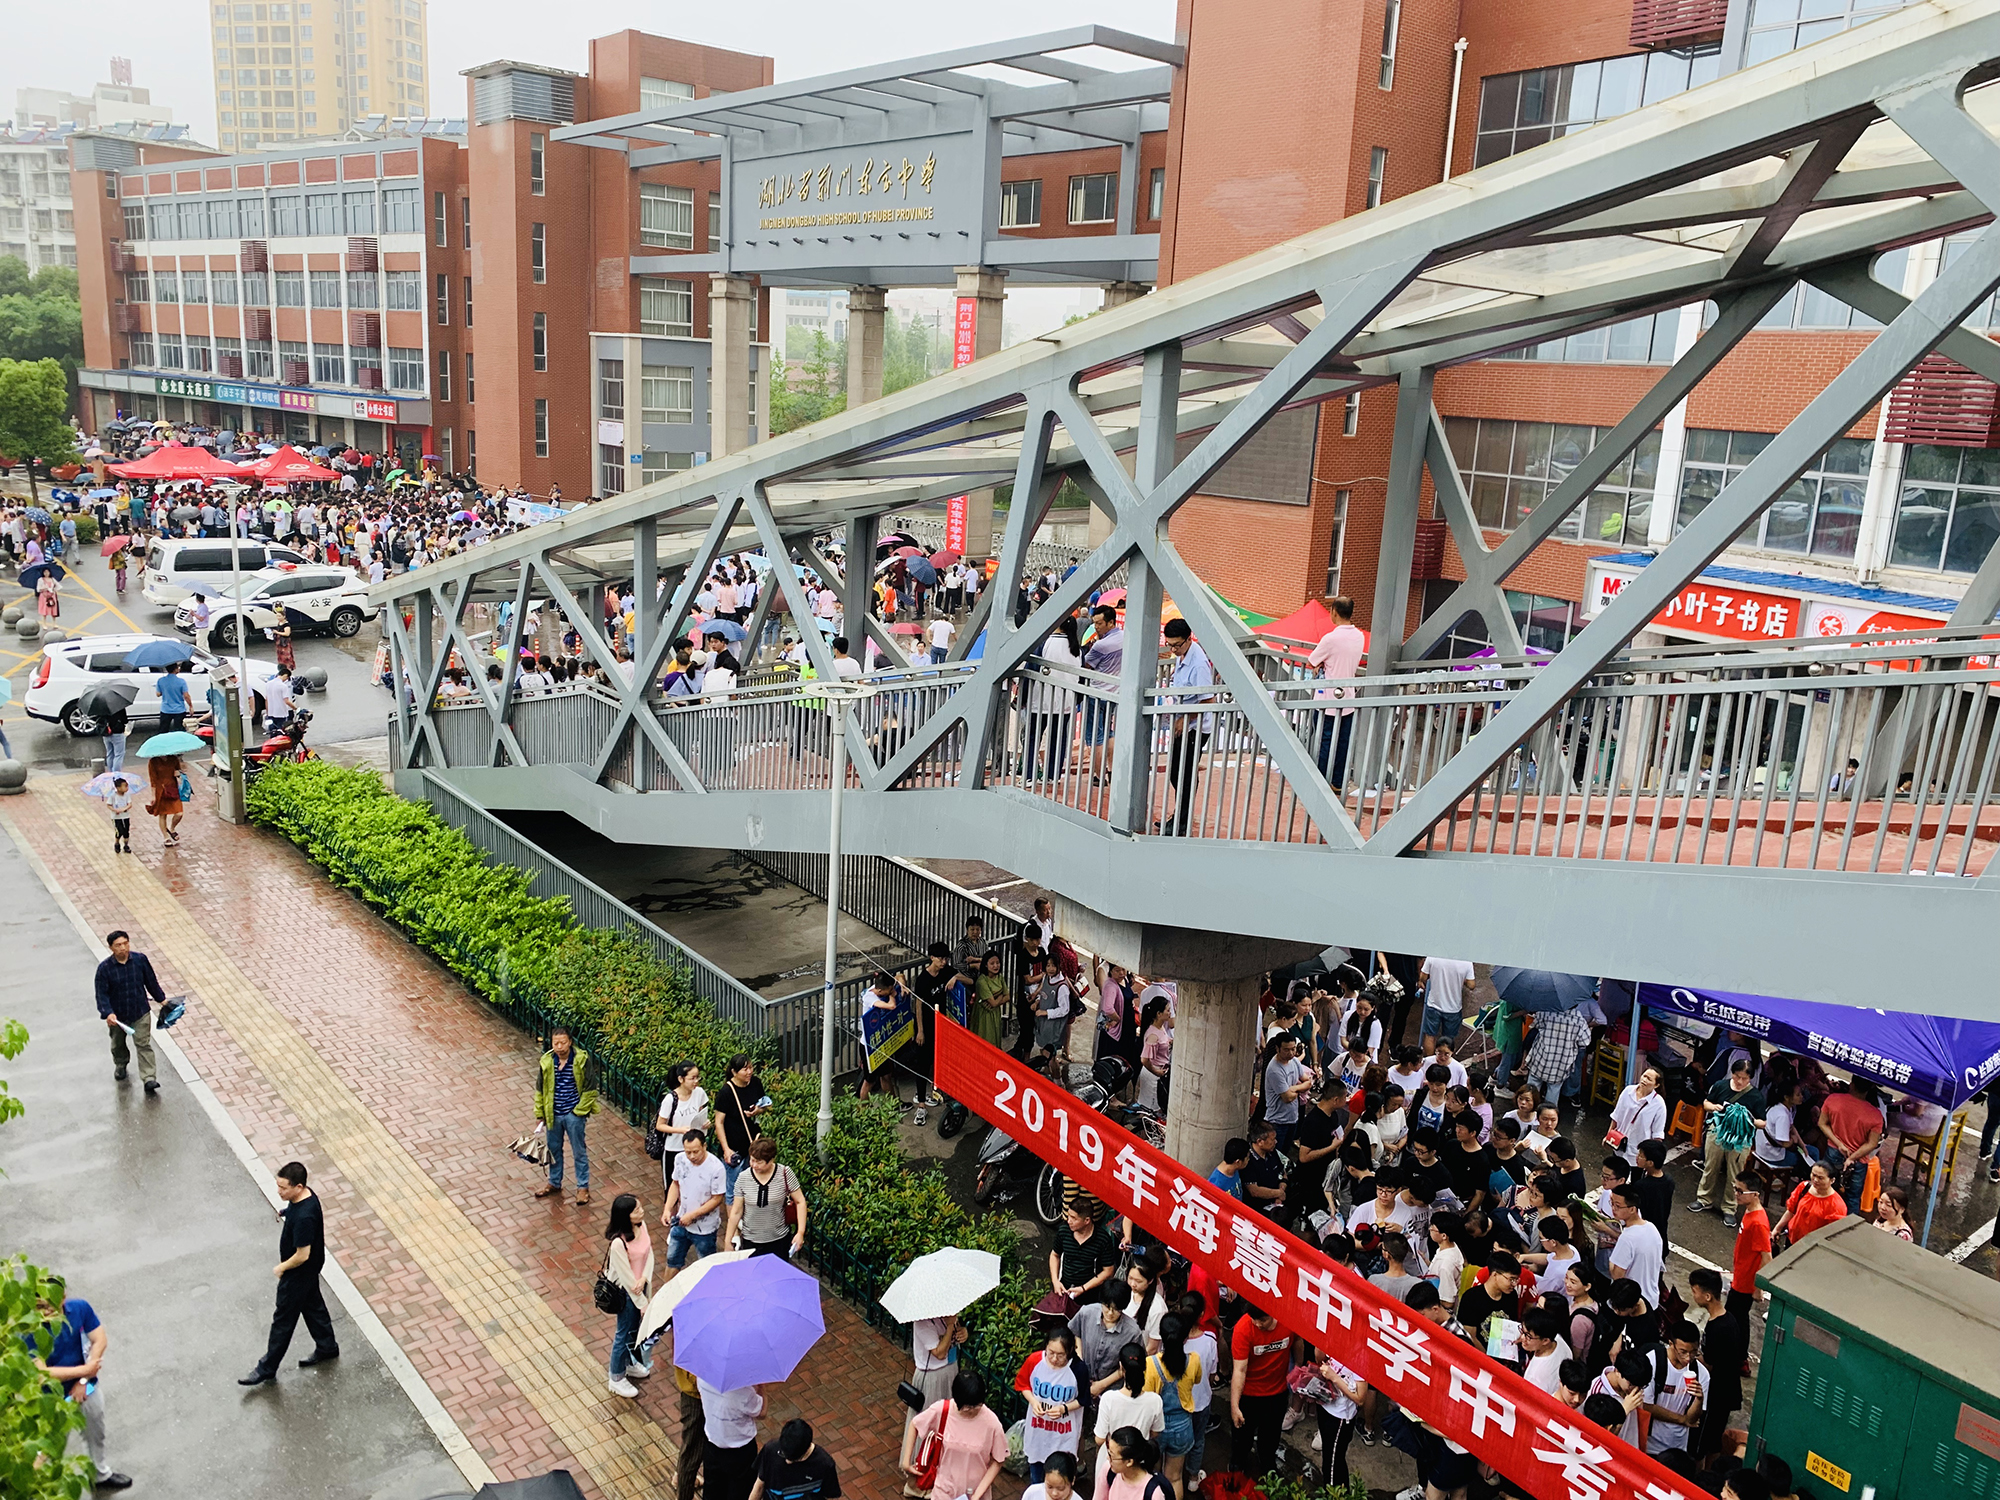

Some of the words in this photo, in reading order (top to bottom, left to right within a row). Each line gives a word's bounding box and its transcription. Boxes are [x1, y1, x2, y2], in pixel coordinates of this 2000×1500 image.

[758, 150, 936, 209] 湖北省荆门东宝中学
[759, 217, 786, 230] JINGMEN
[786, 215, 817, 228] DONGBAO
[817, 213, 834, 227] HIGH
[834, 211, 861, 225] SCHOOL
[863, 211, 873, 223] OF
[873, 209, 895, 222] HUBEI
[895, 206, 934, 221] PROVINCE
[310, 598, 331, 607] 公安
[1665, 591, 1789, 638] 小叶子书店
[1703, 1000, 1771, 1031] 长城宽带
[1806, 1031, 1913, 1084] 智趣体验超宽带
[993, 1069, 1690, 1500] 2019年海慧中学中考
[1033, 1376, 1076, 1402] GOOD
